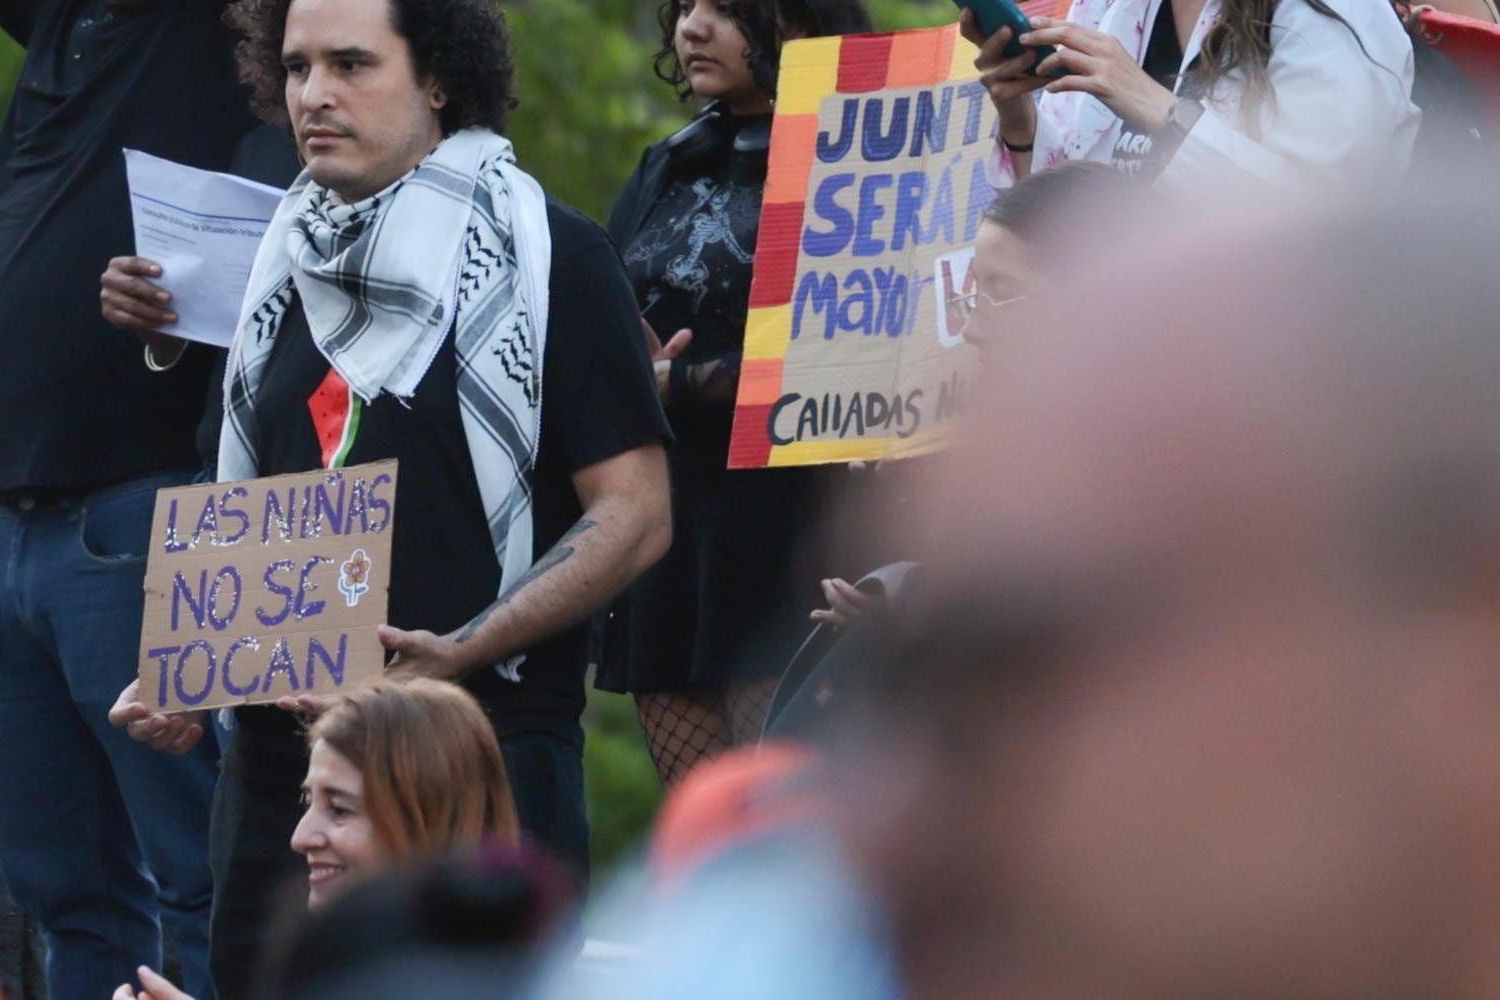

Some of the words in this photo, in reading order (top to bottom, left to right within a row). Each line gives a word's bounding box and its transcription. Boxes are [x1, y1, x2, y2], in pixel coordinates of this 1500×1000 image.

[816, 80, 1000, 163] JUNT
[164, 486, 250, 553] LAS
[260, 470, 392, 545] NIÑAS
[170, 565, 242, 632] NO
[255, 555, 335, 627] SE
[148, 633, 348, 708] TOCAN
